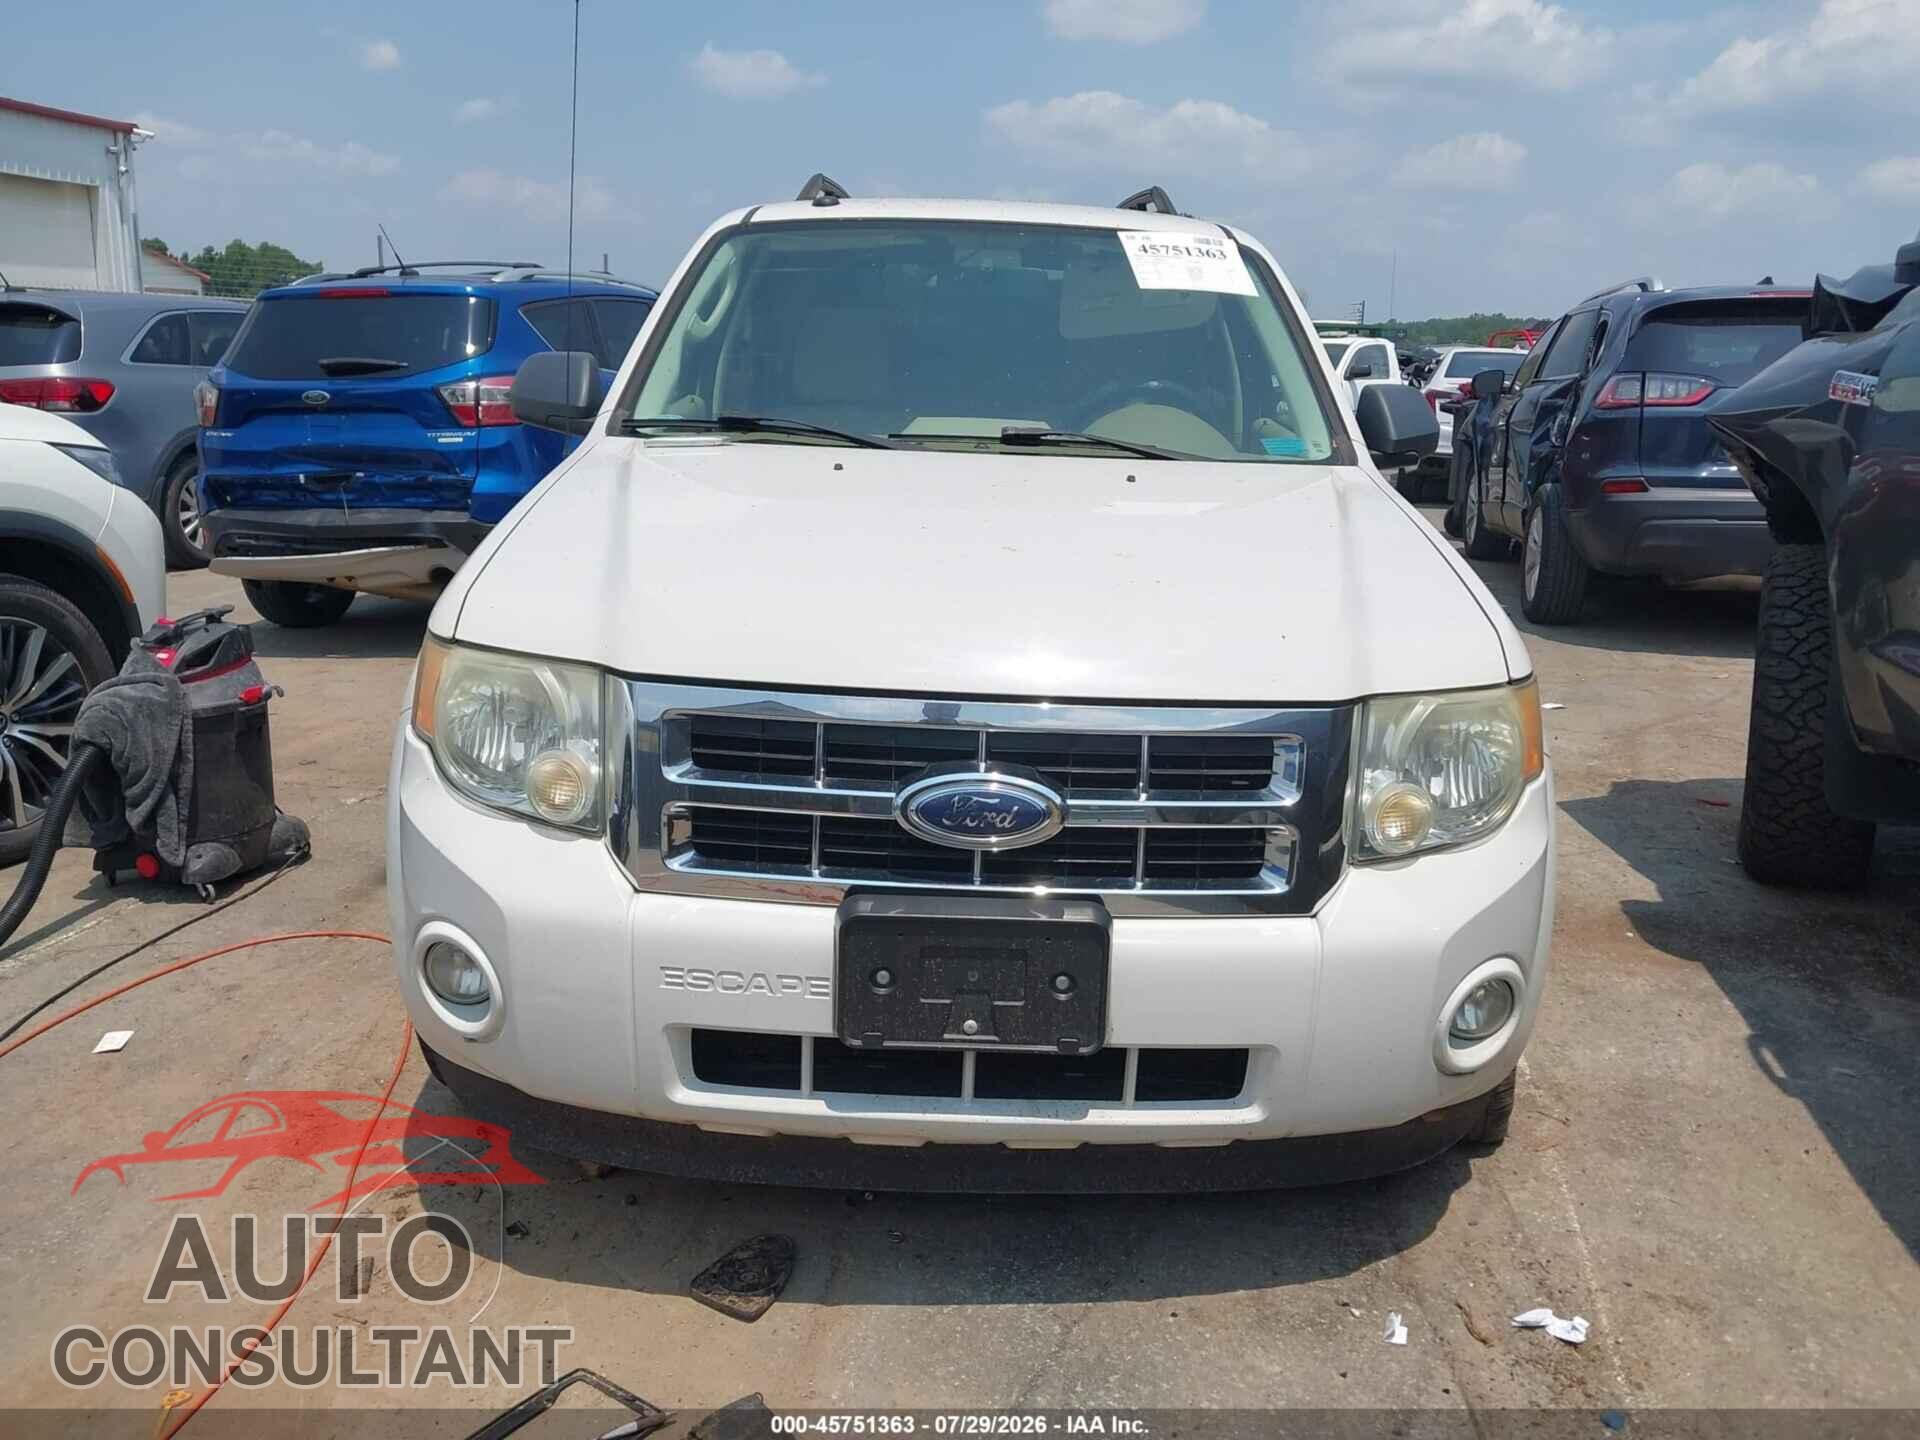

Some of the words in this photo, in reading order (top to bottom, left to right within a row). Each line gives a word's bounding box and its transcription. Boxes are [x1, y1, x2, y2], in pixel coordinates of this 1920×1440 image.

[1137, 243, 1228, 261] 45751363
[941, 793, 1020, 829] Ford
[658, 965, 833, 1000] ESCAPE
